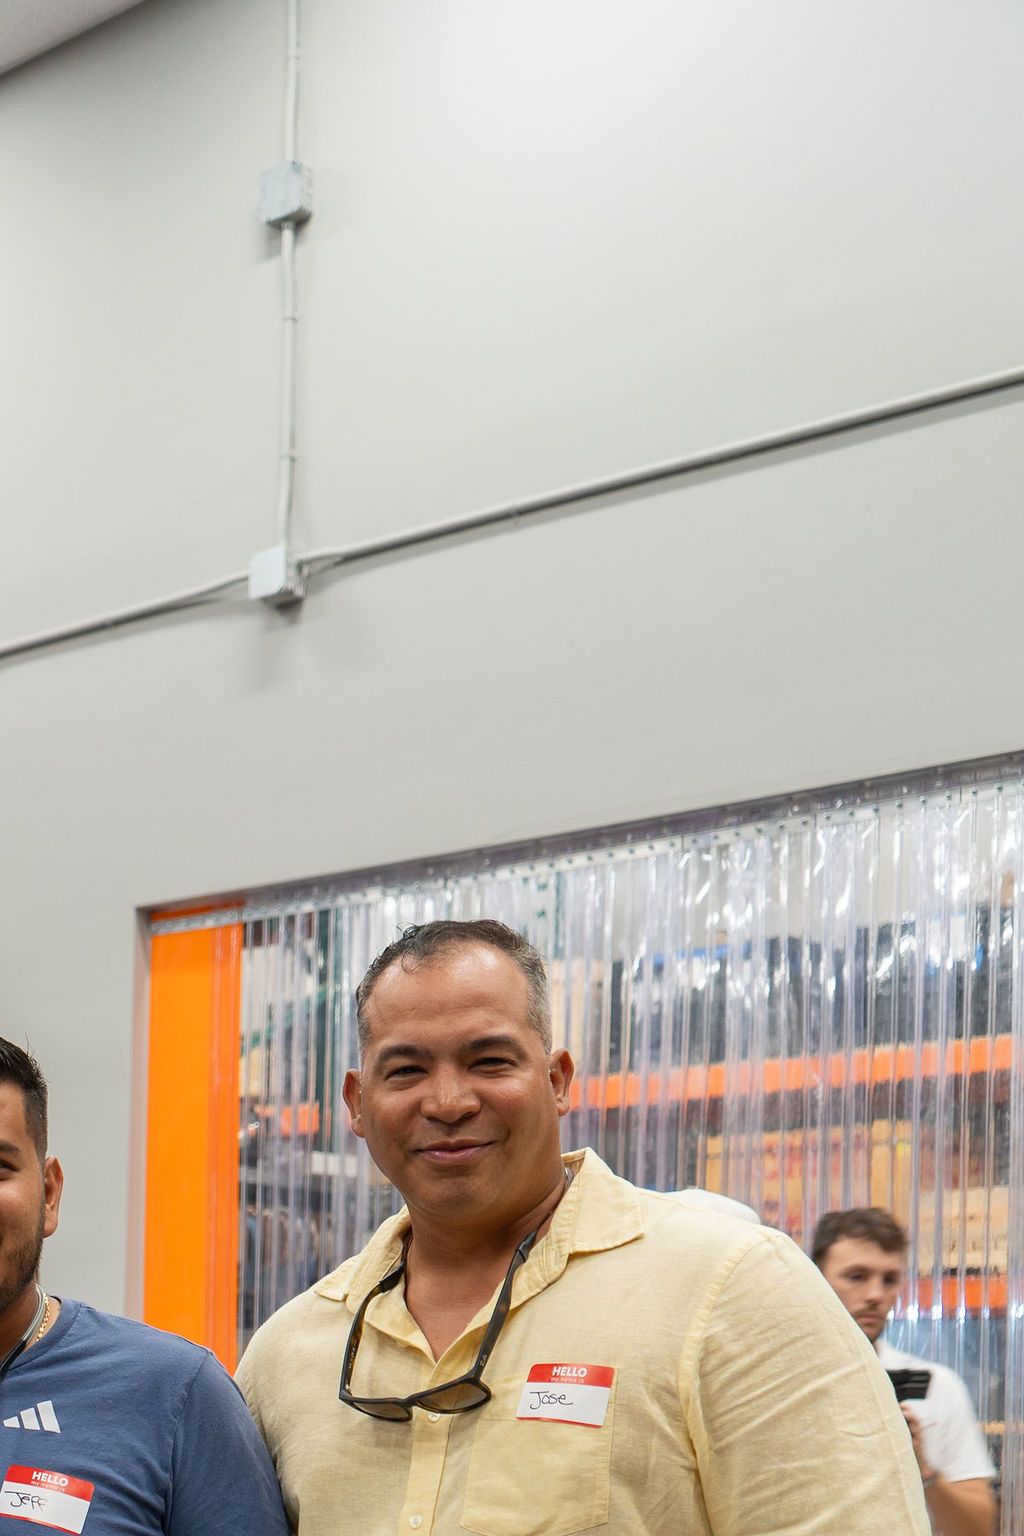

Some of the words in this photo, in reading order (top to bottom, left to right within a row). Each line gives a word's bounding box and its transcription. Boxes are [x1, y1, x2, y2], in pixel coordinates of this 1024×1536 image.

[552, 1366, 588, 1377] HELLO
[529, 1390, 574, 1410] Jose
[31, 1471, 69, 1487] HELLO
